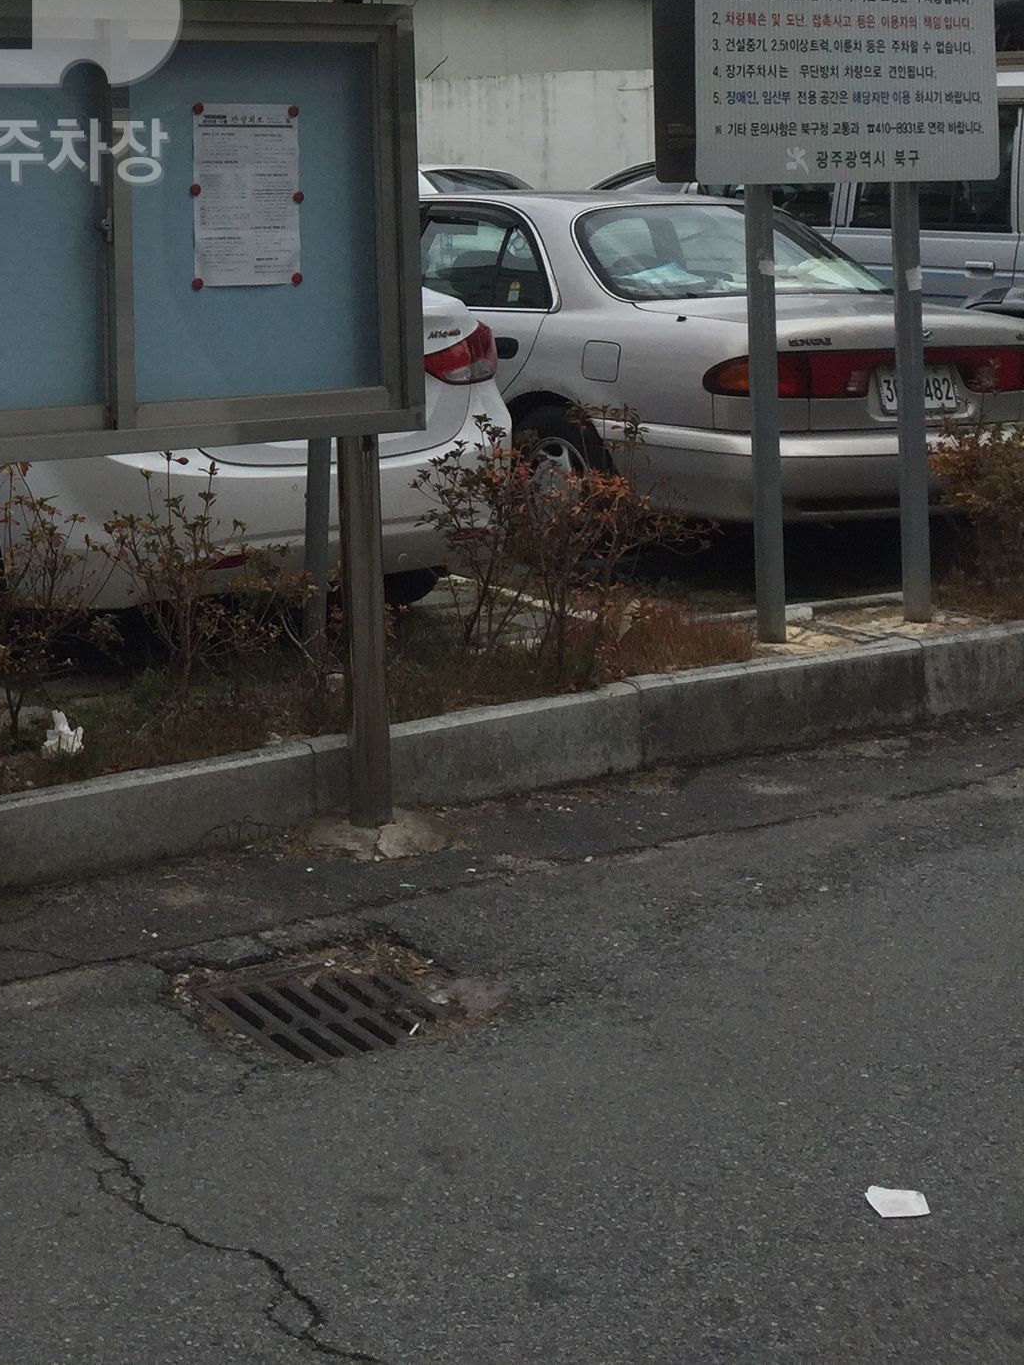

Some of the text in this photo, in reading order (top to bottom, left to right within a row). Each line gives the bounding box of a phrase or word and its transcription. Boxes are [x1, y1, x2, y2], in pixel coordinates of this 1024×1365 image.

[857, 15, 876, 29] 등은
[881, 15, 918, 29] 이용자의
[866, 39, 886, 53] 등은
[923, 40, 931, 53] 수
[800, 64, 839, 78] 무단방치
[844, 65, 882, 79] 차량으로
[762, 91, 791, 104] 임산부
[797, 91, 817, 105] 전용
[820, 90, 849, 105] 공간은
[892, 90, 911, 105] 이용
[915, 91, 943, 104] 하시기
[727, 123, 747, 136] 기타
[750, 122, 797, 136] 문의사항은
[801, 122, 829, 136] 북구청
[832, 122, 860, 135] 교통과
[928, 122, 945, 135] 연락
[816, 150, 920, 169] 광주광역시 북구
